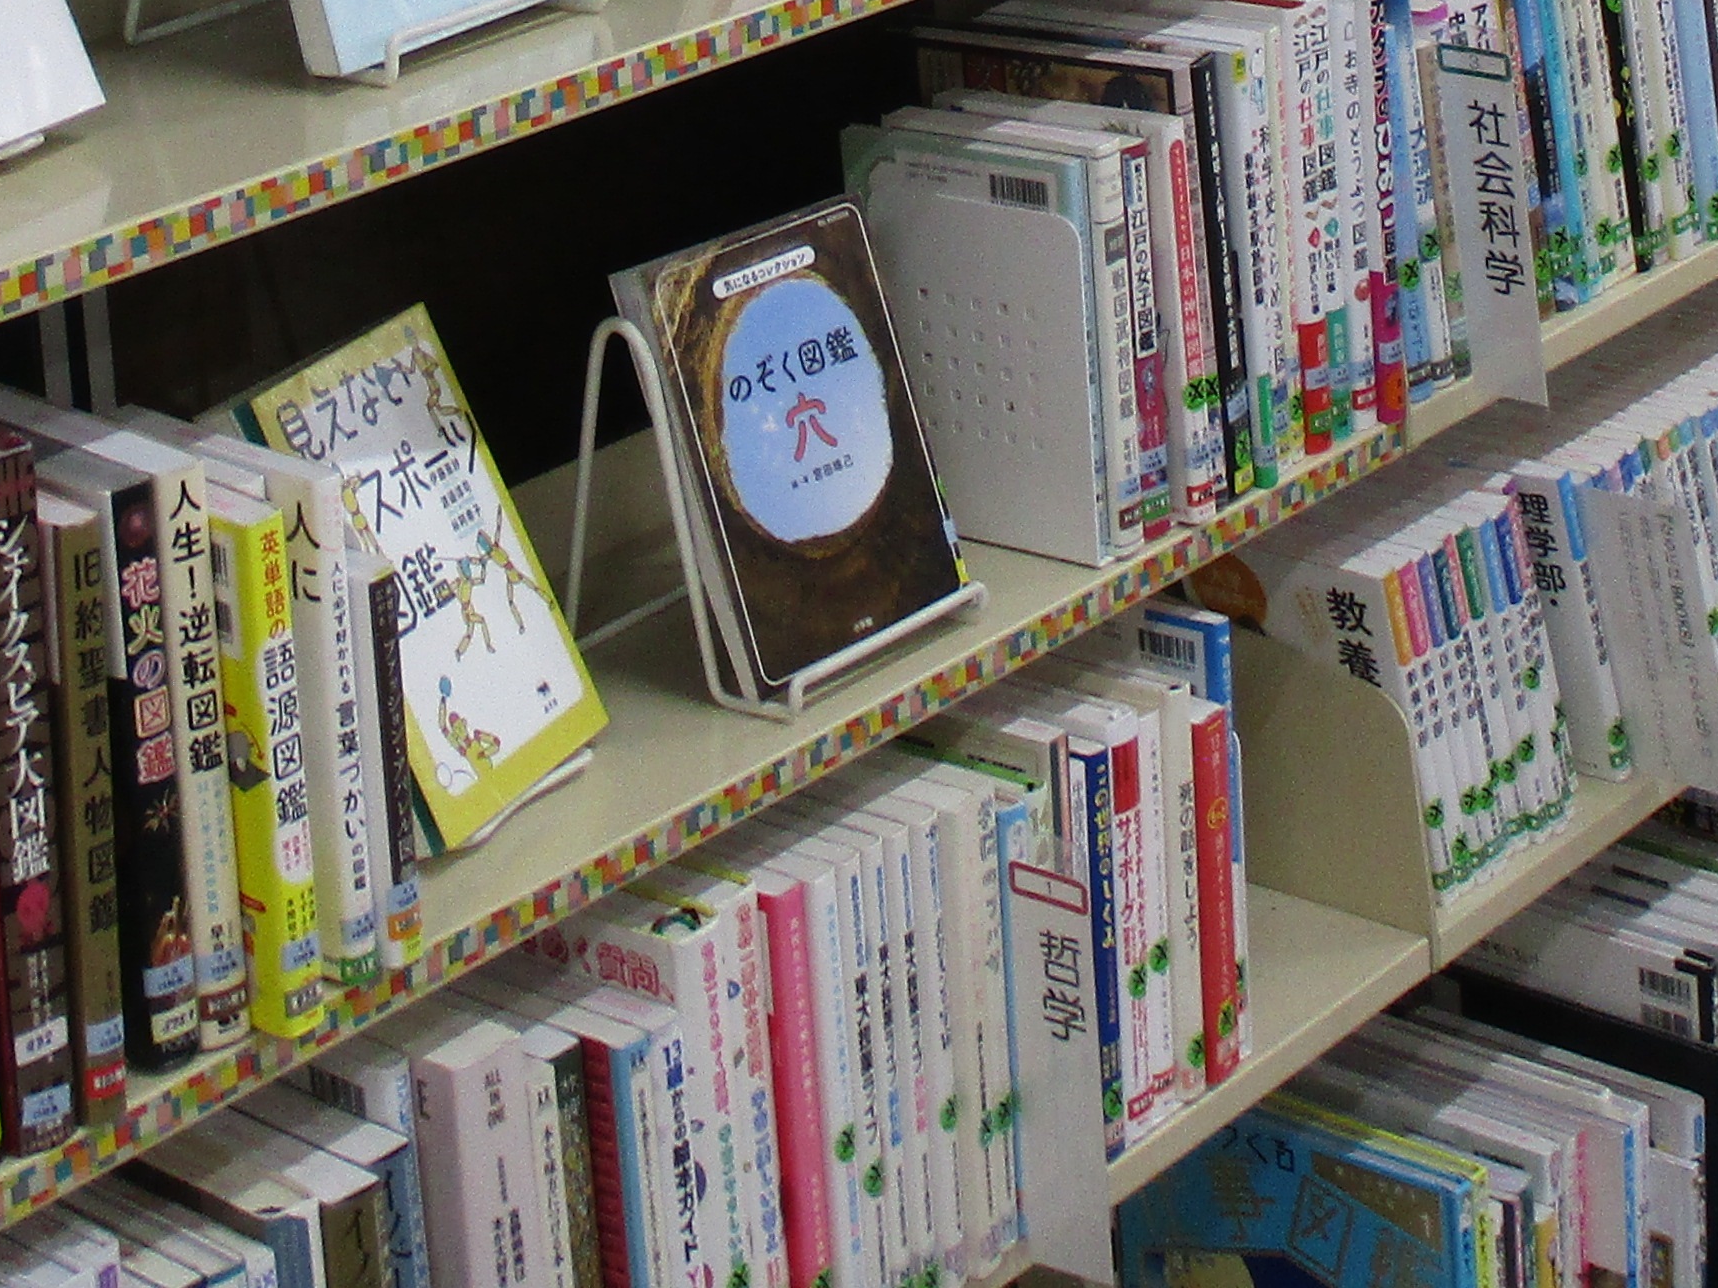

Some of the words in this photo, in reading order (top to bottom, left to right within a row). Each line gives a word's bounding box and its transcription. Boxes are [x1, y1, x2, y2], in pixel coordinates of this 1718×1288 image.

[1467, 99, 1527, 296] 社会科学
[1130, 208, 1157, 355] 江戸の女子図鑑
[276, 355, 412, 461] 見えない
[729, 324, 859, 405] のぞく図鑑
[359, 410, 478, 535] スポーツ
[782, 390, 839, 464] 穴
[284, 499, 323, 603] 人に
[120, 555, 178, 787] 花火の図鑑
[258, 527, 309, 825] 英単語の語源図鑑
[1325, 586, 1383, 689] 教養
[72, 549, 120, 935] 旧約聖書人物図鑑
[1042, 929, 1087, 1042] 哲学
